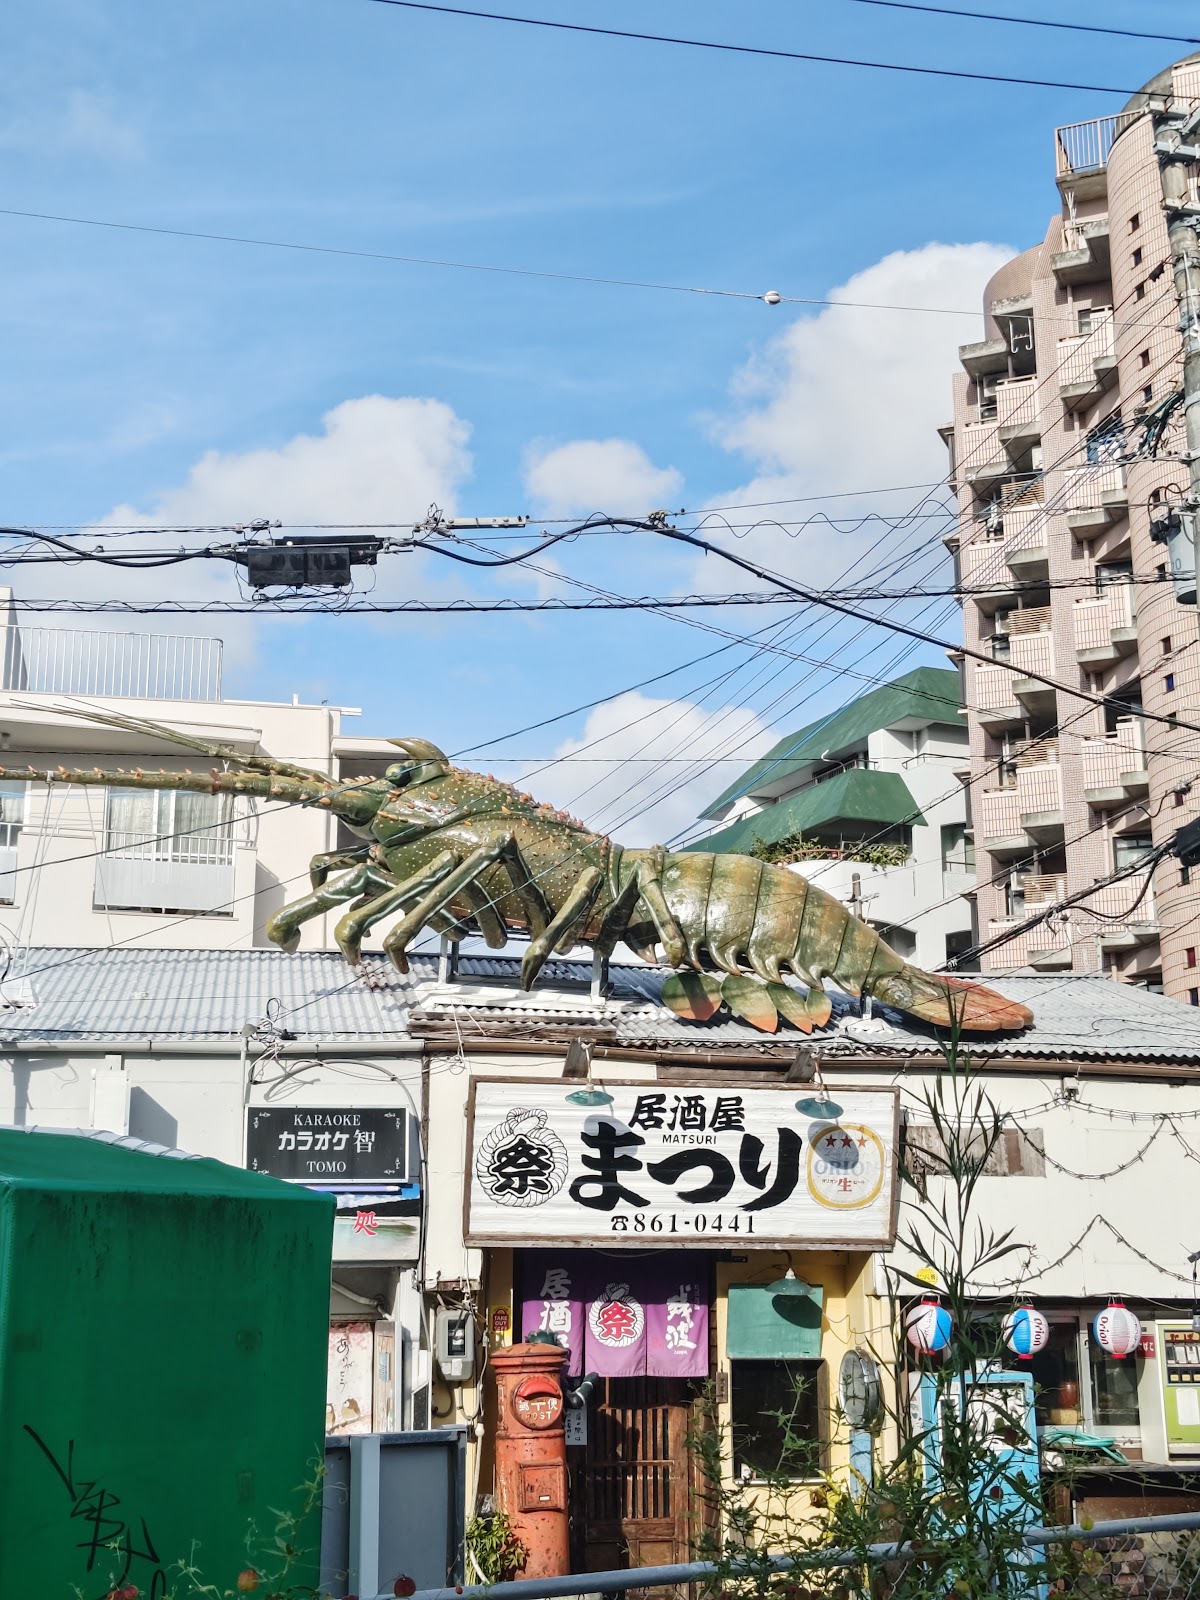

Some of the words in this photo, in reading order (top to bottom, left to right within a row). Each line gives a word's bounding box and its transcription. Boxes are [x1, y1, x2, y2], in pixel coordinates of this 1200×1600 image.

[293, 1114, 361, 1126] KARAOKE
[628, 1094, 745, 1132] 居酒屋
[662, 1134, 717, 1145] MATSURI
[306, 1160, 347, 1173] TOMO
[490, 1136, 555, 1195] 祭
[568, 1122, 802, 1211] まつり
[353, 1211, 378, 1236] 処
[633, 1213, 755, 1233] 861-0441
[539, 1268, 572, 1349] 居酒
[598, 1301, 634, 1340] 祭
[1033, 1317, 1043, 1346] Orion
[1100, 1316, 1109, 1345] Orion
